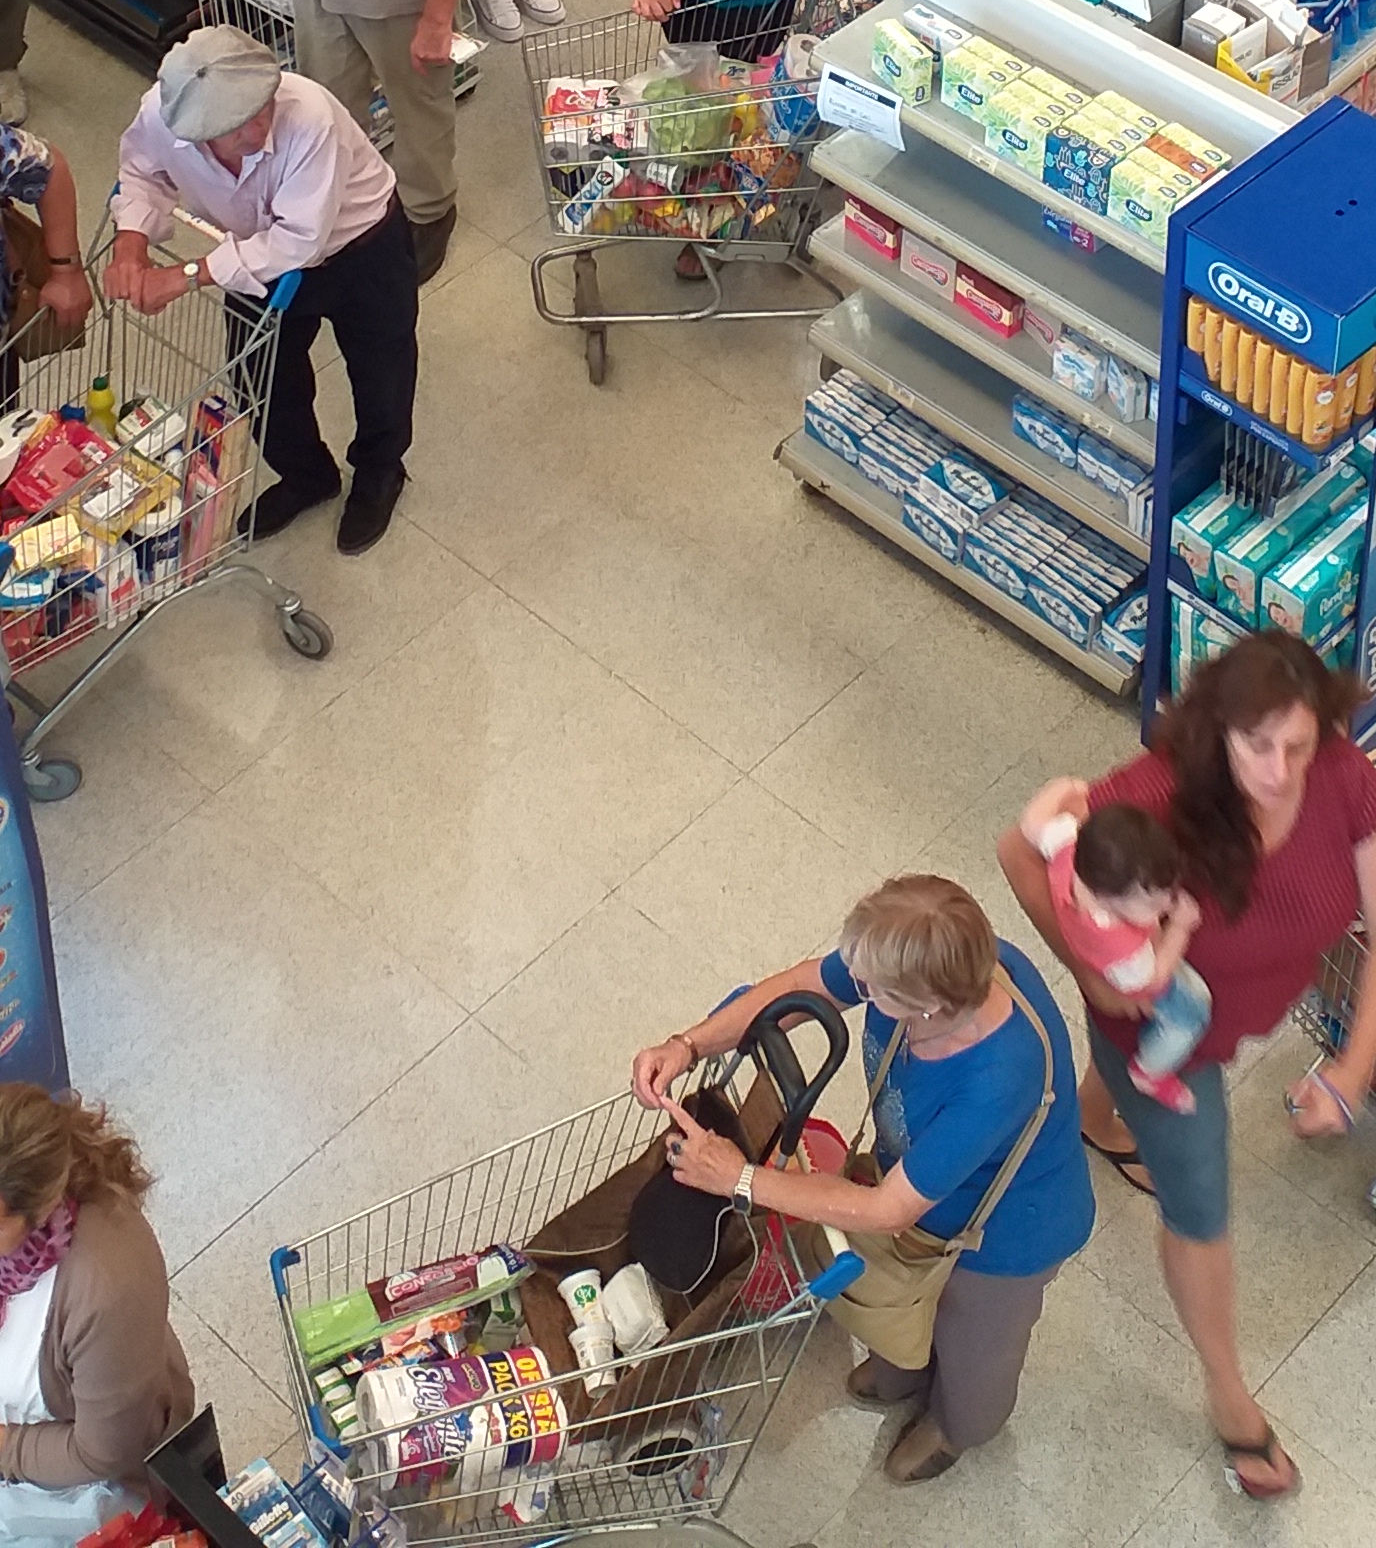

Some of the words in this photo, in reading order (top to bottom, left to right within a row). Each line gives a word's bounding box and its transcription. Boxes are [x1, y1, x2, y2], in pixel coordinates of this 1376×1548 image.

[959, 85, 983, 104] Elite
[1003, 130, 1027, 150] Elite
[1063, 168, 1087, 187] Elite
[1128, 200, 1152, 221] Elite
[1216, 271, 1300, 334] Oral-B
[230, 1491, 244, 1506] 40
[249, 1500, 290, 1534] Gillette
